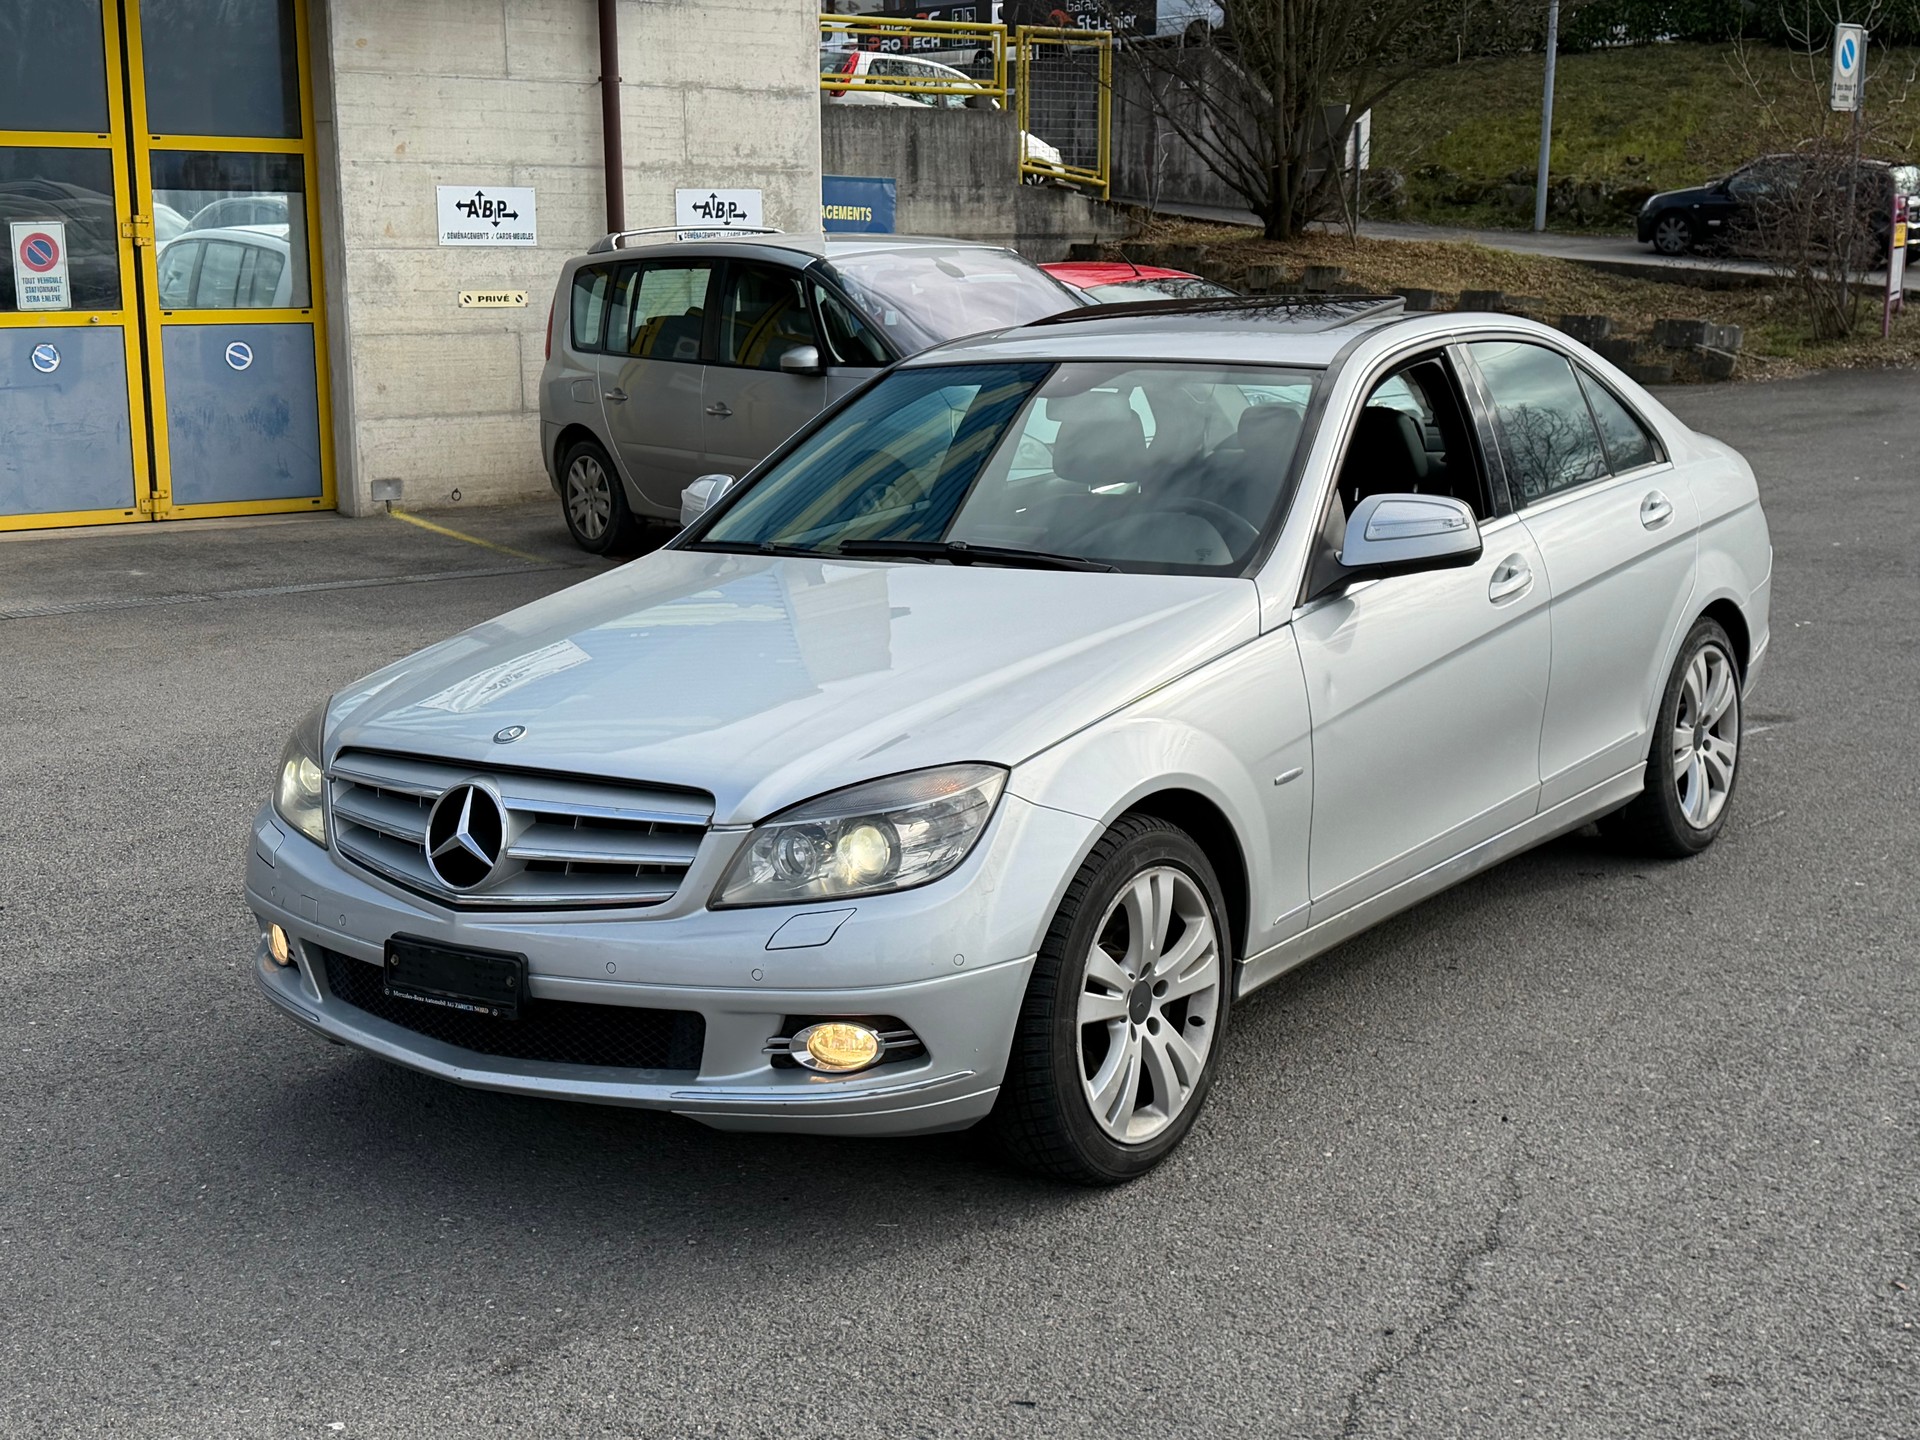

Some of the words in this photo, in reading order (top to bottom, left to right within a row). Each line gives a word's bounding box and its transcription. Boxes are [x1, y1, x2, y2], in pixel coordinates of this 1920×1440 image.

[467, 199, 507, 218] ABP
[702, 201, 737, 219] ABP
[477, 294, 510, 303] PRIVÉ
